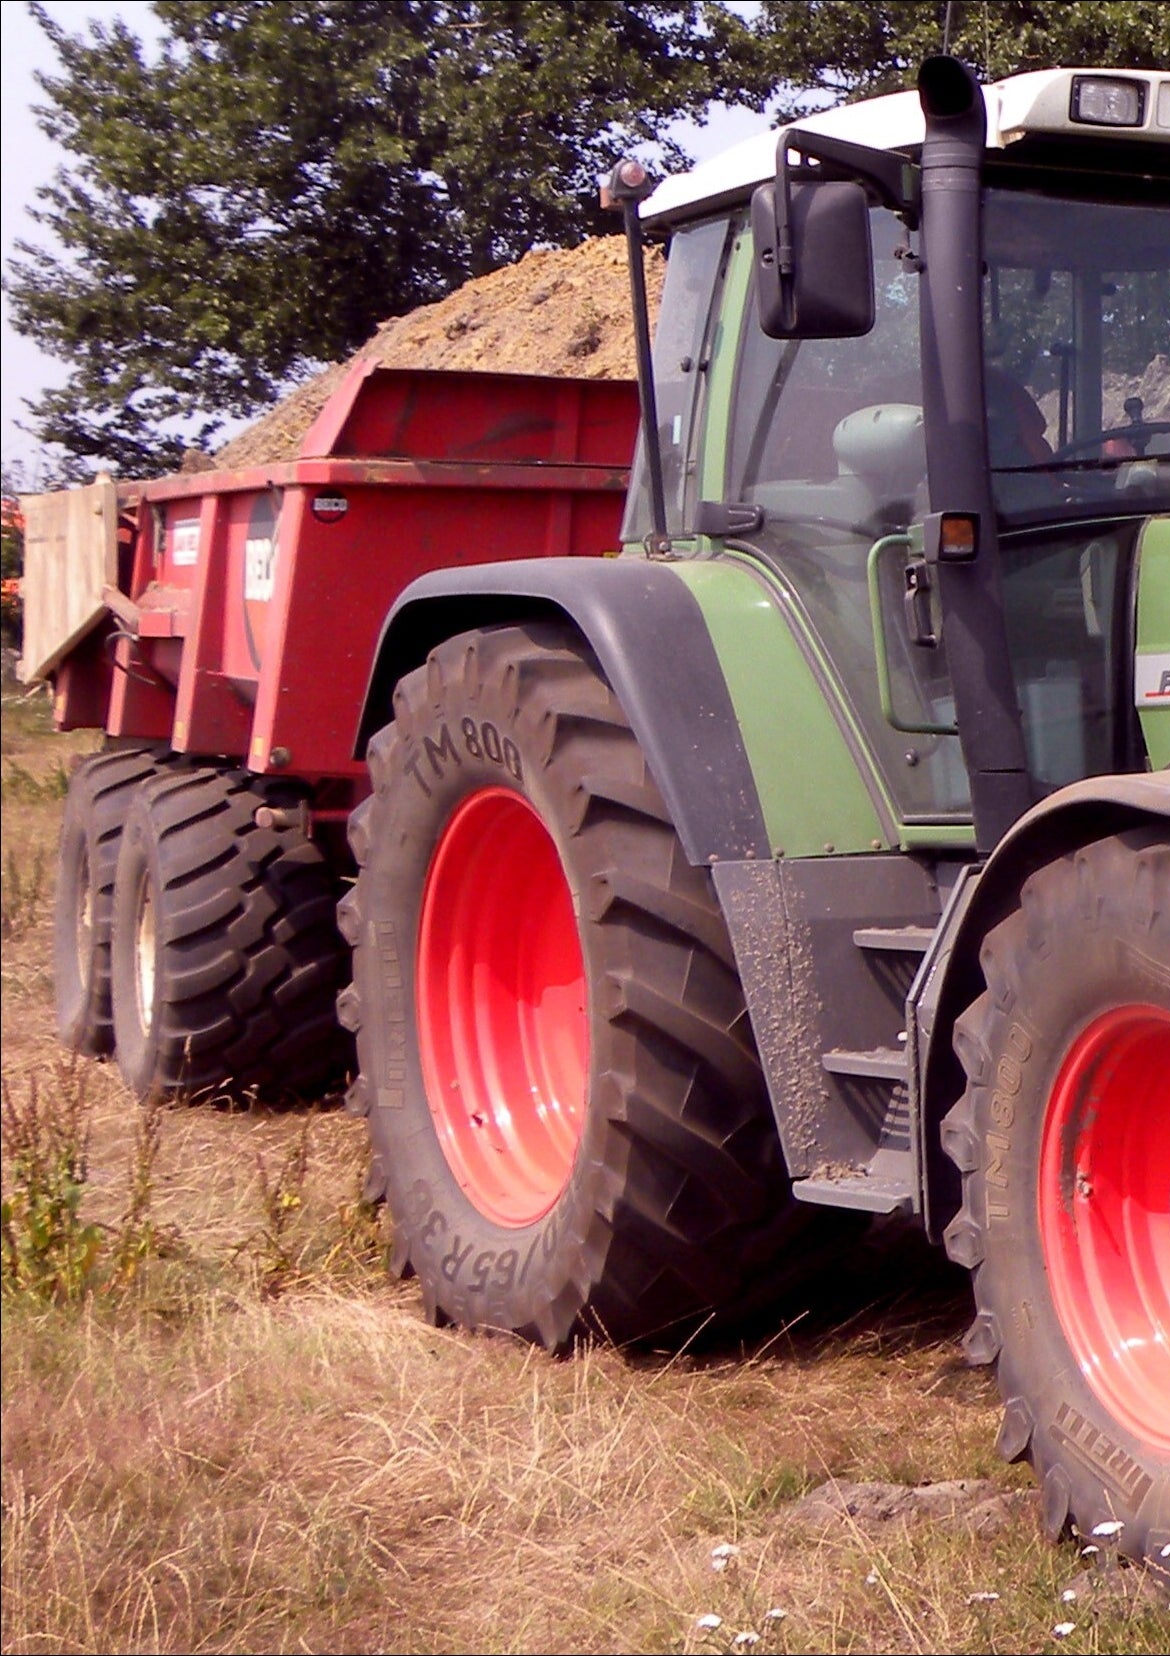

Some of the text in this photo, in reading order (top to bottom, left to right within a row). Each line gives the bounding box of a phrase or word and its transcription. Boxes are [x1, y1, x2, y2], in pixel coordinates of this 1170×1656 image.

[404, 717, 525, 798] TM 800
[985, 1022, 1032, 1230] TM 800
[1054, 1402, 1154, 1520] PIRELLI
